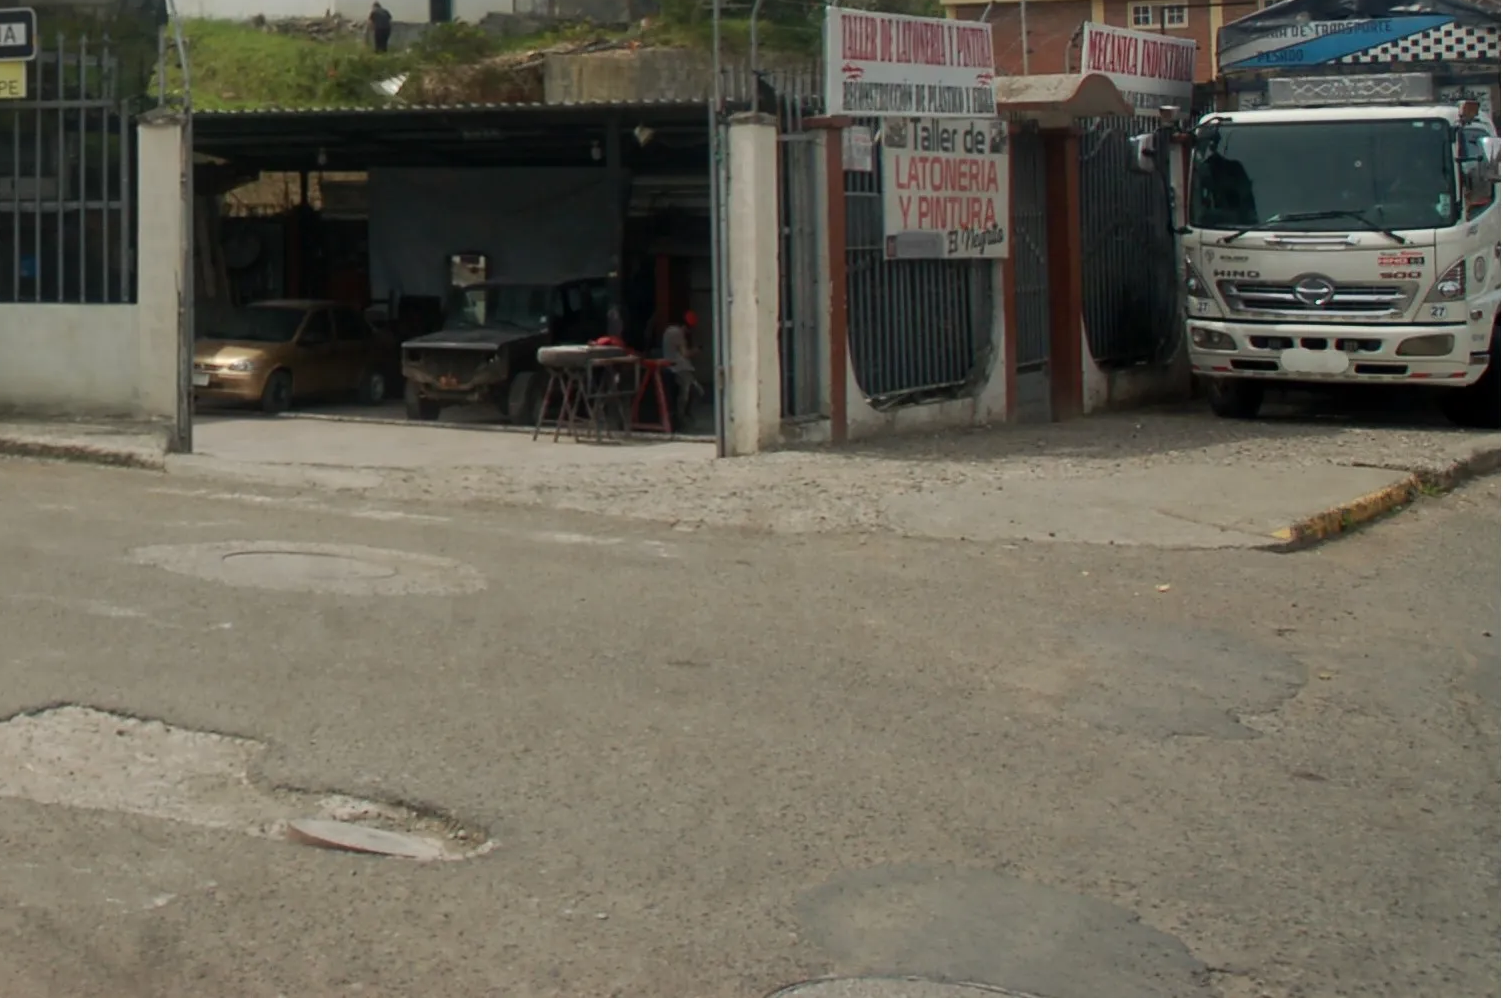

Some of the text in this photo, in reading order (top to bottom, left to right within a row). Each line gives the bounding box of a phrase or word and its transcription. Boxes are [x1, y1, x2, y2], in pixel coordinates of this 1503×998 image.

[842, 14, 877, 60] TALLER
[880, 18, 893, 62] DE
[947, 25, 954, 66] Y
[1291, 25, 1308, 38] DE
[1314, 20, 1393, 36] TRANSPORTE
[1257, 49, 1304, 63] PESADO
[910, 117, 957, 152] Taller
[964, 121, 985, 154] de
[895, 155, 998, 193] LATONERIA
[899, 196, 996, 230] Y PINTURA
[1213, 269, 1260, 278] HINO
[1431, 305, 1445, 317] 27
